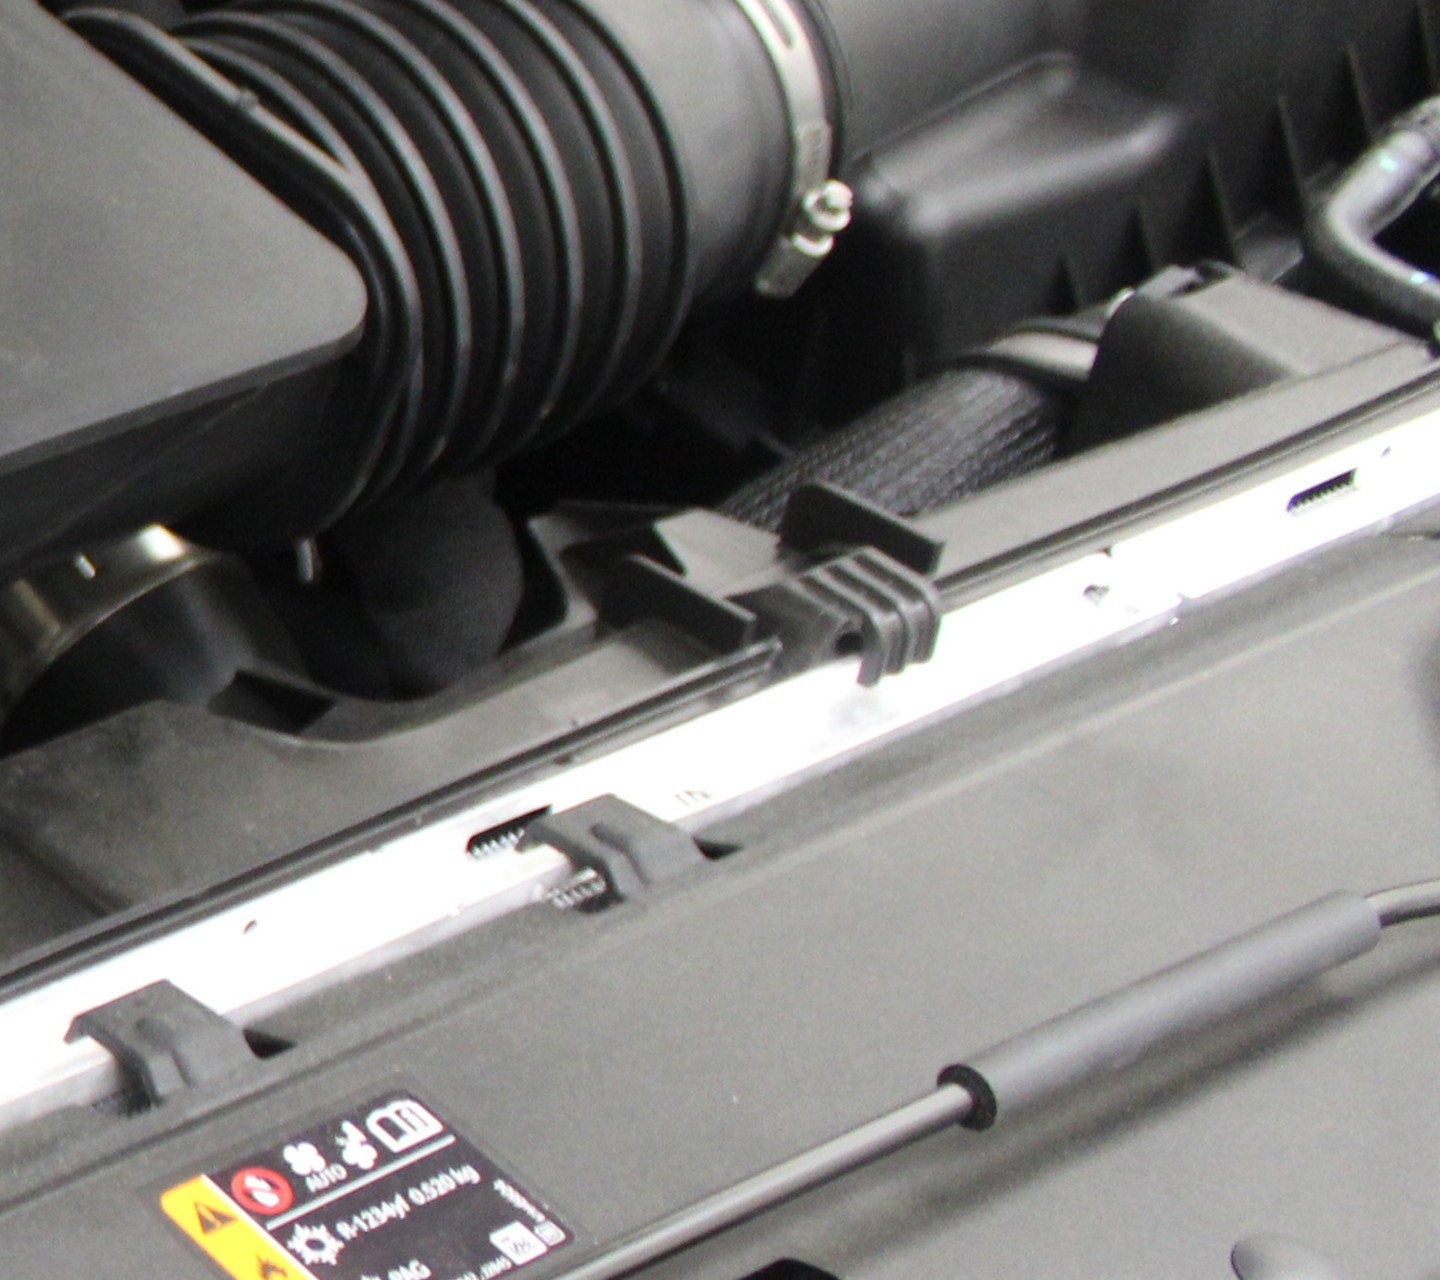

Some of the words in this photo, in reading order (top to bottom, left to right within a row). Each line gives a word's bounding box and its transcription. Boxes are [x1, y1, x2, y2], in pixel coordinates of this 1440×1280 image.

[305, 1163, 348, 1192] AUTO
[335, 1191, 411, 1241] R-1234yf
[407, 1172, 457, 1206] 0.520
[449, 1164, 481, 1185] kg
